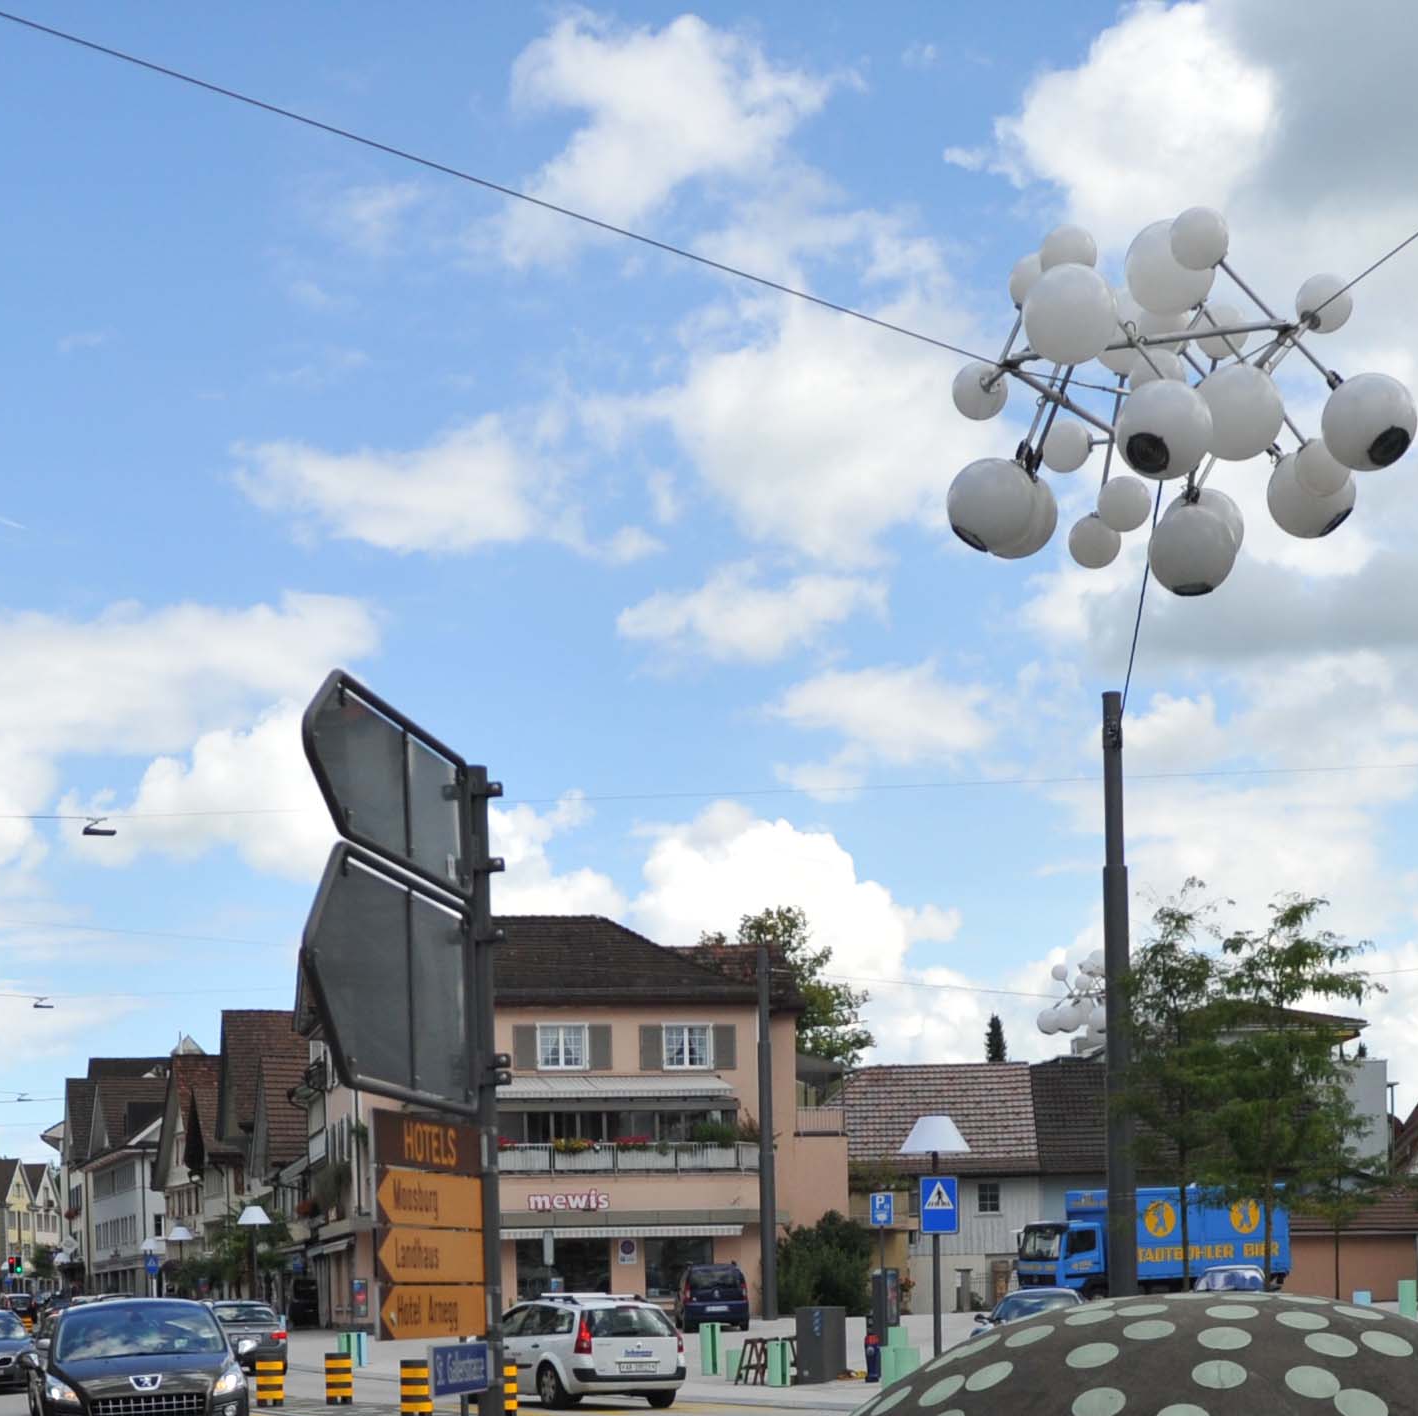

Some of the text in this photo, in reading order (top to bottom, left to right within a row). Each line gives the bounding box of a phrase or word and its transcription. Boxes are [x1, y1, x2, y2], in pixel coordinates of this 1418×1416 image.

[403, 1119, 458, 1168] HOTELS
[393, 1178, 439, 1222] Moosburg
[528, 1187, 610, 1211] mewis
[394, 1236, 440, 1270] Landhaus
[396, 1293, 459, 1333] Hotel Arnegg
